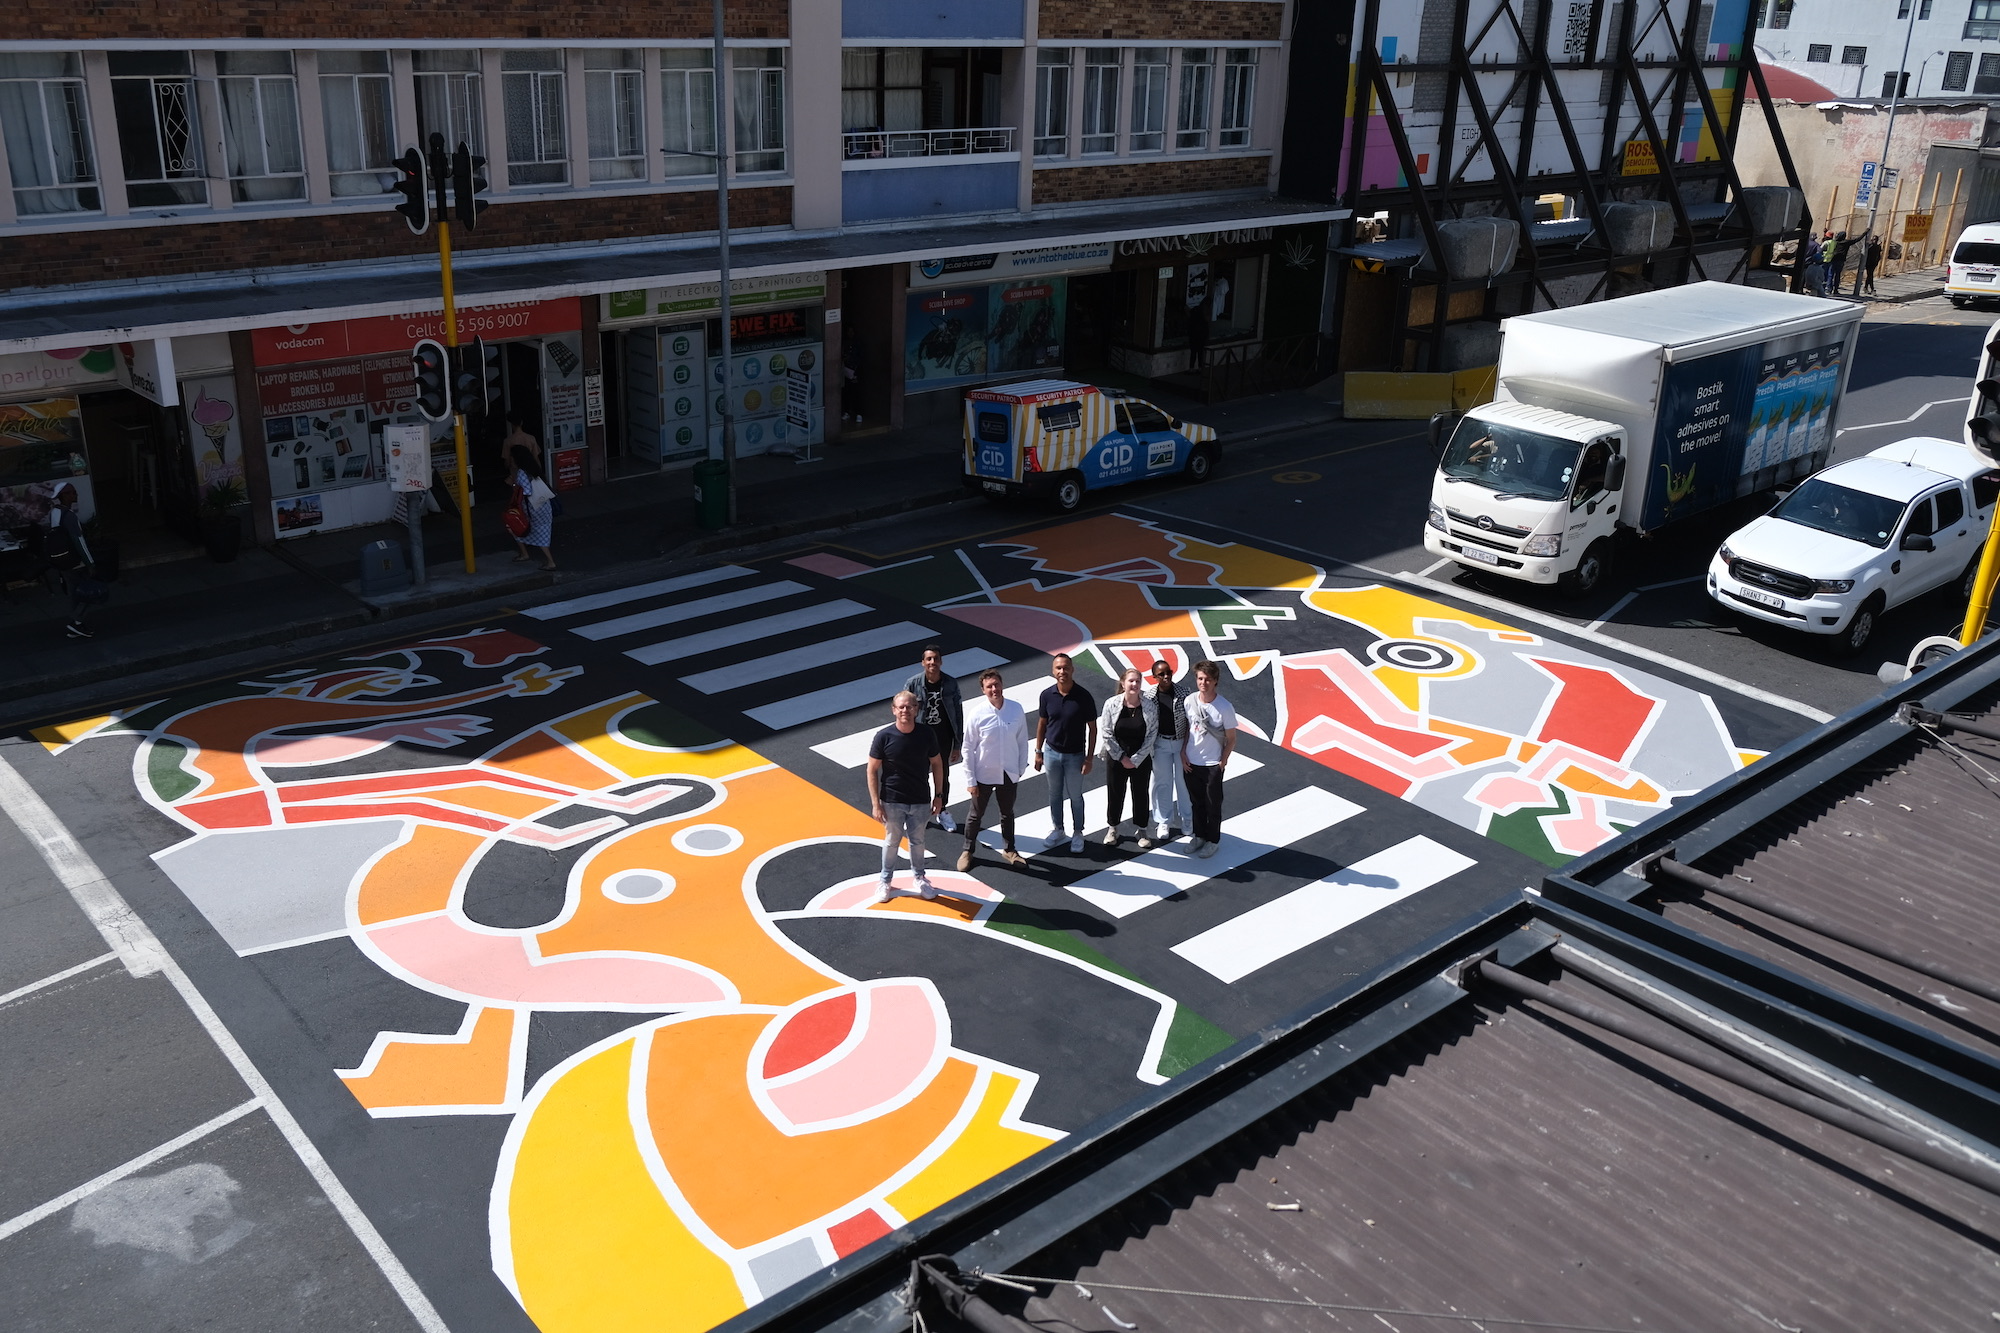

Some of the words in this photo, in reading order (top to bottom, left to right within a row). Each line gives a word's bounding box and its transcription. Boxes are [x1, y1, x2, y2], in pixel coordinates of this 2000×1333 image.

[1462, 129, 1481, 140] EIGH
[1625, 158, 1658, 167] DEMOLITIO
[1865, 164, 1873, 173] P
[1907, 216, 1926, 227] ROSS
[1213, 227, 1274, 246] PORIUM
[1119, 236, 1182, 256] CANNA
[1012, 249, 1109, 267] www.intotheblue.co.za
[677, 282, 743, 297] ELECTROCS
[748, 281, 754, 289] &
[759, 277, 802, 288] PRINTING
[806, 274, 822, 282] CO.
[1010, 291, 1024, 299] SCUBA
[1024, 290, 1033, 298] FUN
[1033, 288, 1045, 296] DIVES
[928, 299, 943, 309] SCUBA
[943, 298, 954, 308] DIVE
[954, 297, 966, 306] SHOP
[407, 322, 437, 339] Cell:
[439, 319, 465, 335] 03
[469, 315, 494, 332] 596
[498, 311, 531, 329] 9007
[738, 316, 765, 332] WE
[769, 312, 795, 329] FIX
[275, 337, 325, 350] vodacom
[1807, 352, 1819, 361] Bostik
[1829, 346, 1840, 356] Bostik
[365, 359, 391, 372] CELLPHONE
[391, 356, 412, 369] REPAIRS,
[1764, 363, 1776, 372] Bostik
[1786, 357, 1798, 366] Bostik
[1, 365, 75, 388] parlour
[259, 372, 288, 387] LAPTOP
[289, 369, 322, 383] REPAIRS,
[322, 364, 361, 379] HARDWARE
[382, 371, 406, 385] NETWORK
[1798, 372, 1818, 385] Prestik
[290, 384, 320, 398] BROKEN
[321, 382, 335, 394] LCD
[1696, 380, 1724, 400] Bostik
[1776, 378, 1797, 391] Prestik
[385, 385, 416, 399] ACCESSORIES
[970, 392, 997, 401] SECURITY
[997, 394, 1018, 403] PATROL
[1035, 391, 1063, 401] SECURITY
[1063, 388, 1085, 397] PATROL
[263, 405, 277, 417] ALL
[278, 398, 327, 413] ACCESSORIES
[327, 392, 365, 407] AVAILABLE
[370, 400, 412, 416] We
[1693, 398, 1720, 417] smart
[1676, 416, 1718, 439] adhesives
[1718, 413, 1730, 426] on
[1113, 437, 1125, 445] POINT
[1680, 439, 1695, 454] the
[1695, 429, 1723, 449] move!
[981, 449, 1005, 467] CID
[1099, 444, 1133, 470] CID
[198, 460, 243, 485] Venezia
[1098, 471, 1109, 479] 021
[1109, 468, 1119, 476] 434
[1120, 466, 1132, 475] 1234
[1445, 505, 1460, 513] HINO
[1470, 549, 1477, 557] 22
[1742, 589, 1761, 601] SHAN3
[1772, 598, 1781, 606] WP
